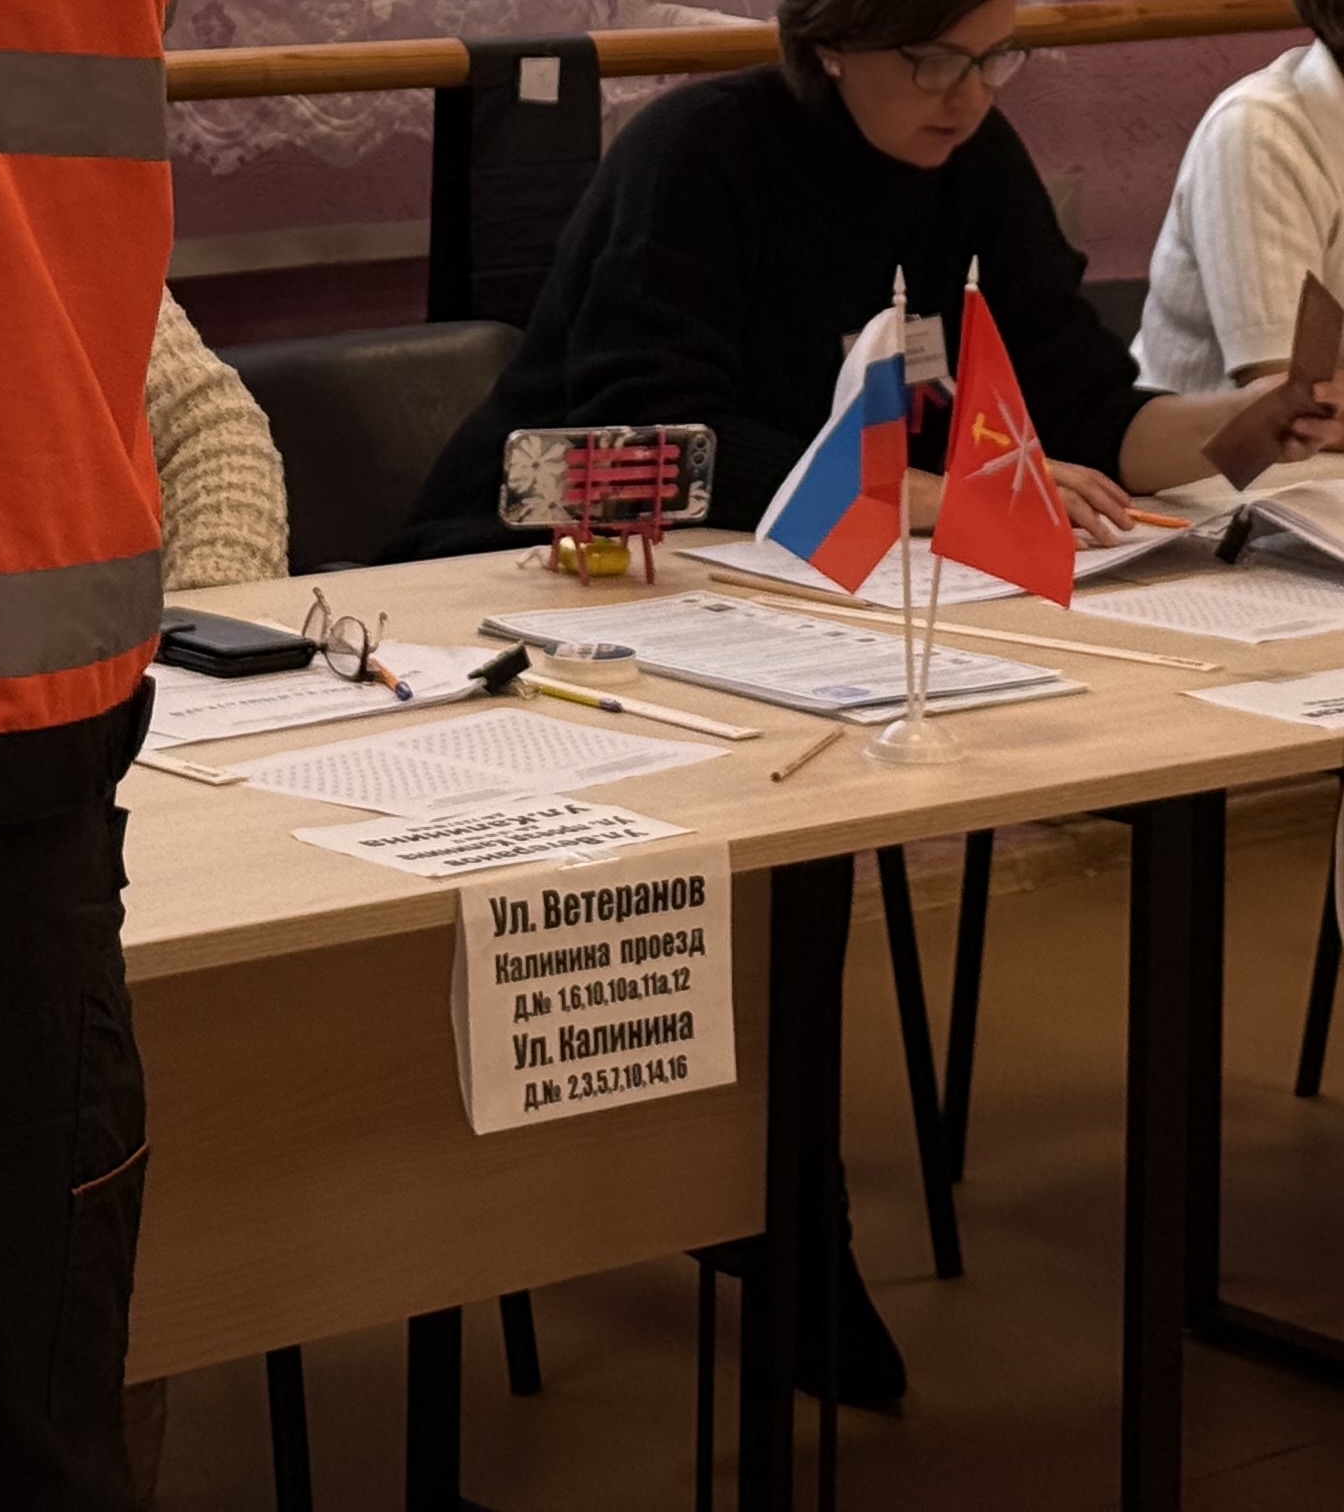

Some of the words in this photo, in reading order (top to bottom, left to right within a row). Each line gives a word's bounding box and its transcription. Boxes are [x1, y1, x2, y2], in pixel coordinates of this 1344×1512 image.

[489, 895, 537, 938] Ул.
[542, 874, 706, 930] Ветеранов
[495, 941, 611, 985] Калинина
[620, 927, 706, 965] проезд
[512, 1032, 553, 1071] Ул.
[558, 1010, 694, 1062] Калинина
